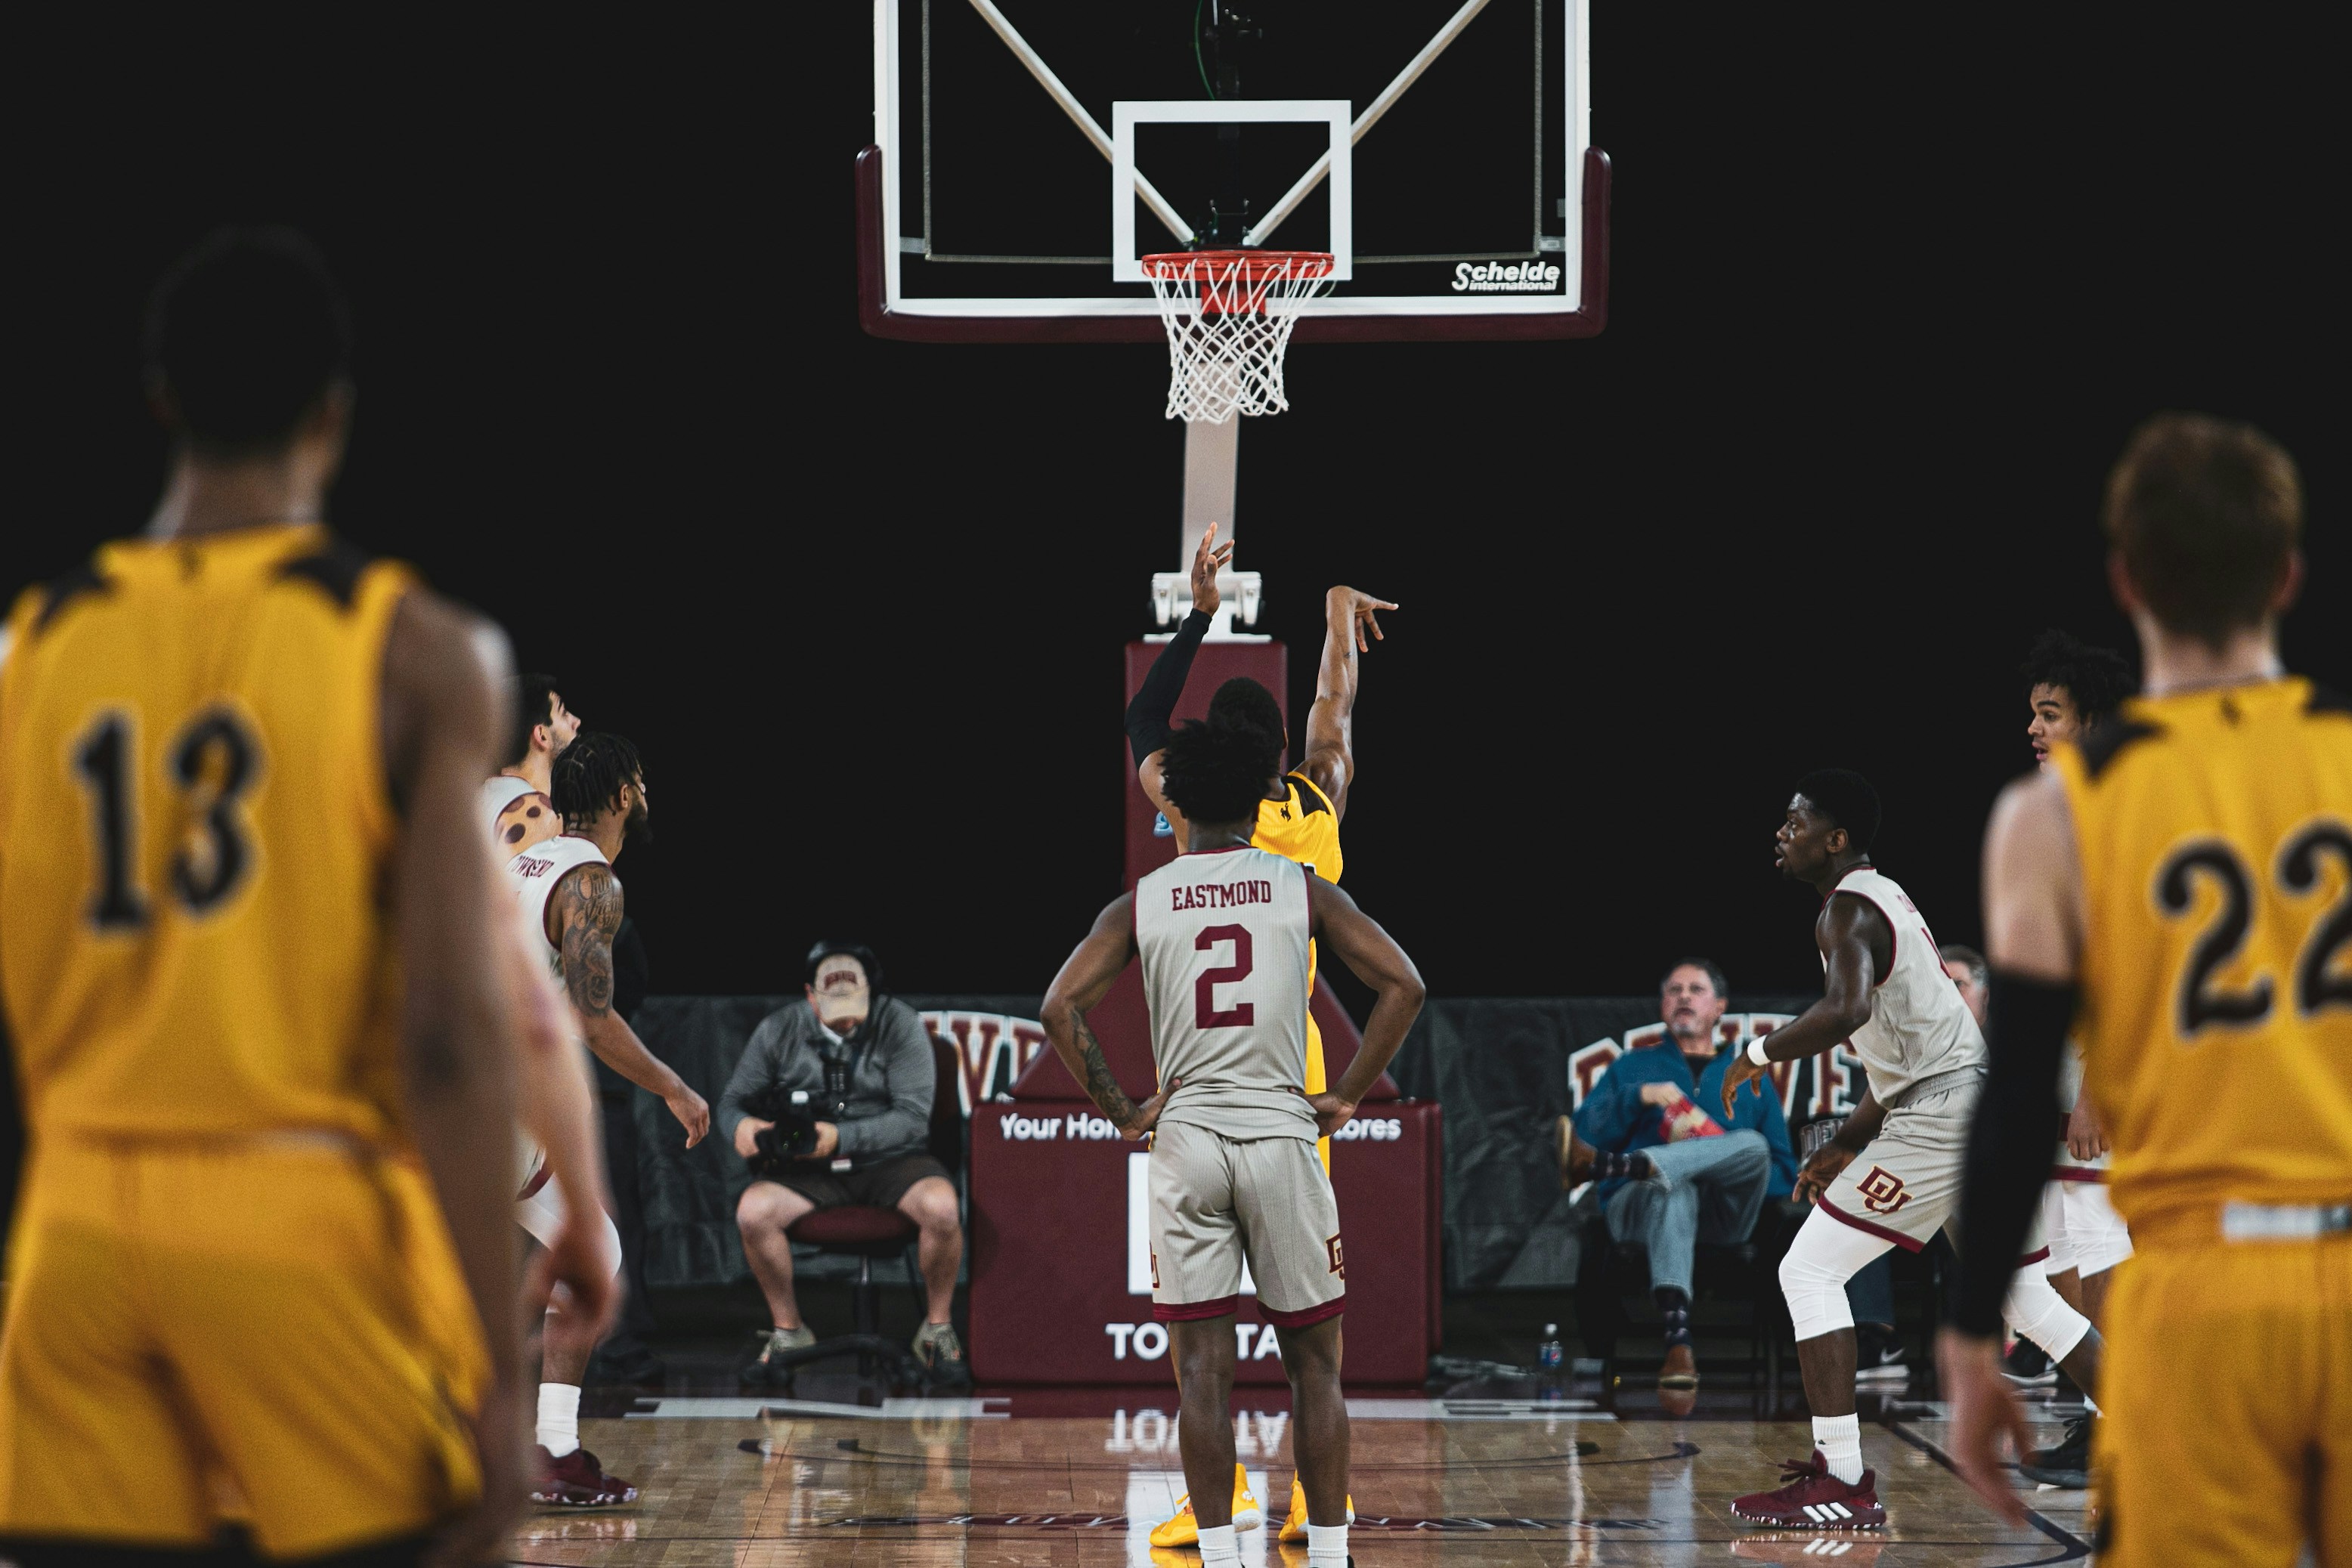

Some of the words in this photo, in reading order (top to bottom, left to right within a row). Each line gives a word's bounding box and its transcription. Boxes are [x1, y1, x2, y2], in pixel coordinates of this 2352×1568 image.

[1451, 261, 1561, 291] Schelde
[1468, 280, 1558, 291] international
[77, 709, 261, 933] 13
[1171, 880, 1271, 911] EASTMOND
[2155, 820, 2352, 1038] 22
[1195, 923, 1254, 1029] 2
[1000, 1112, 1062, 1140] Your
[1855, 1164, 1913, 1214] DU
[1105, 1322, 1282, 1360] TOTA
